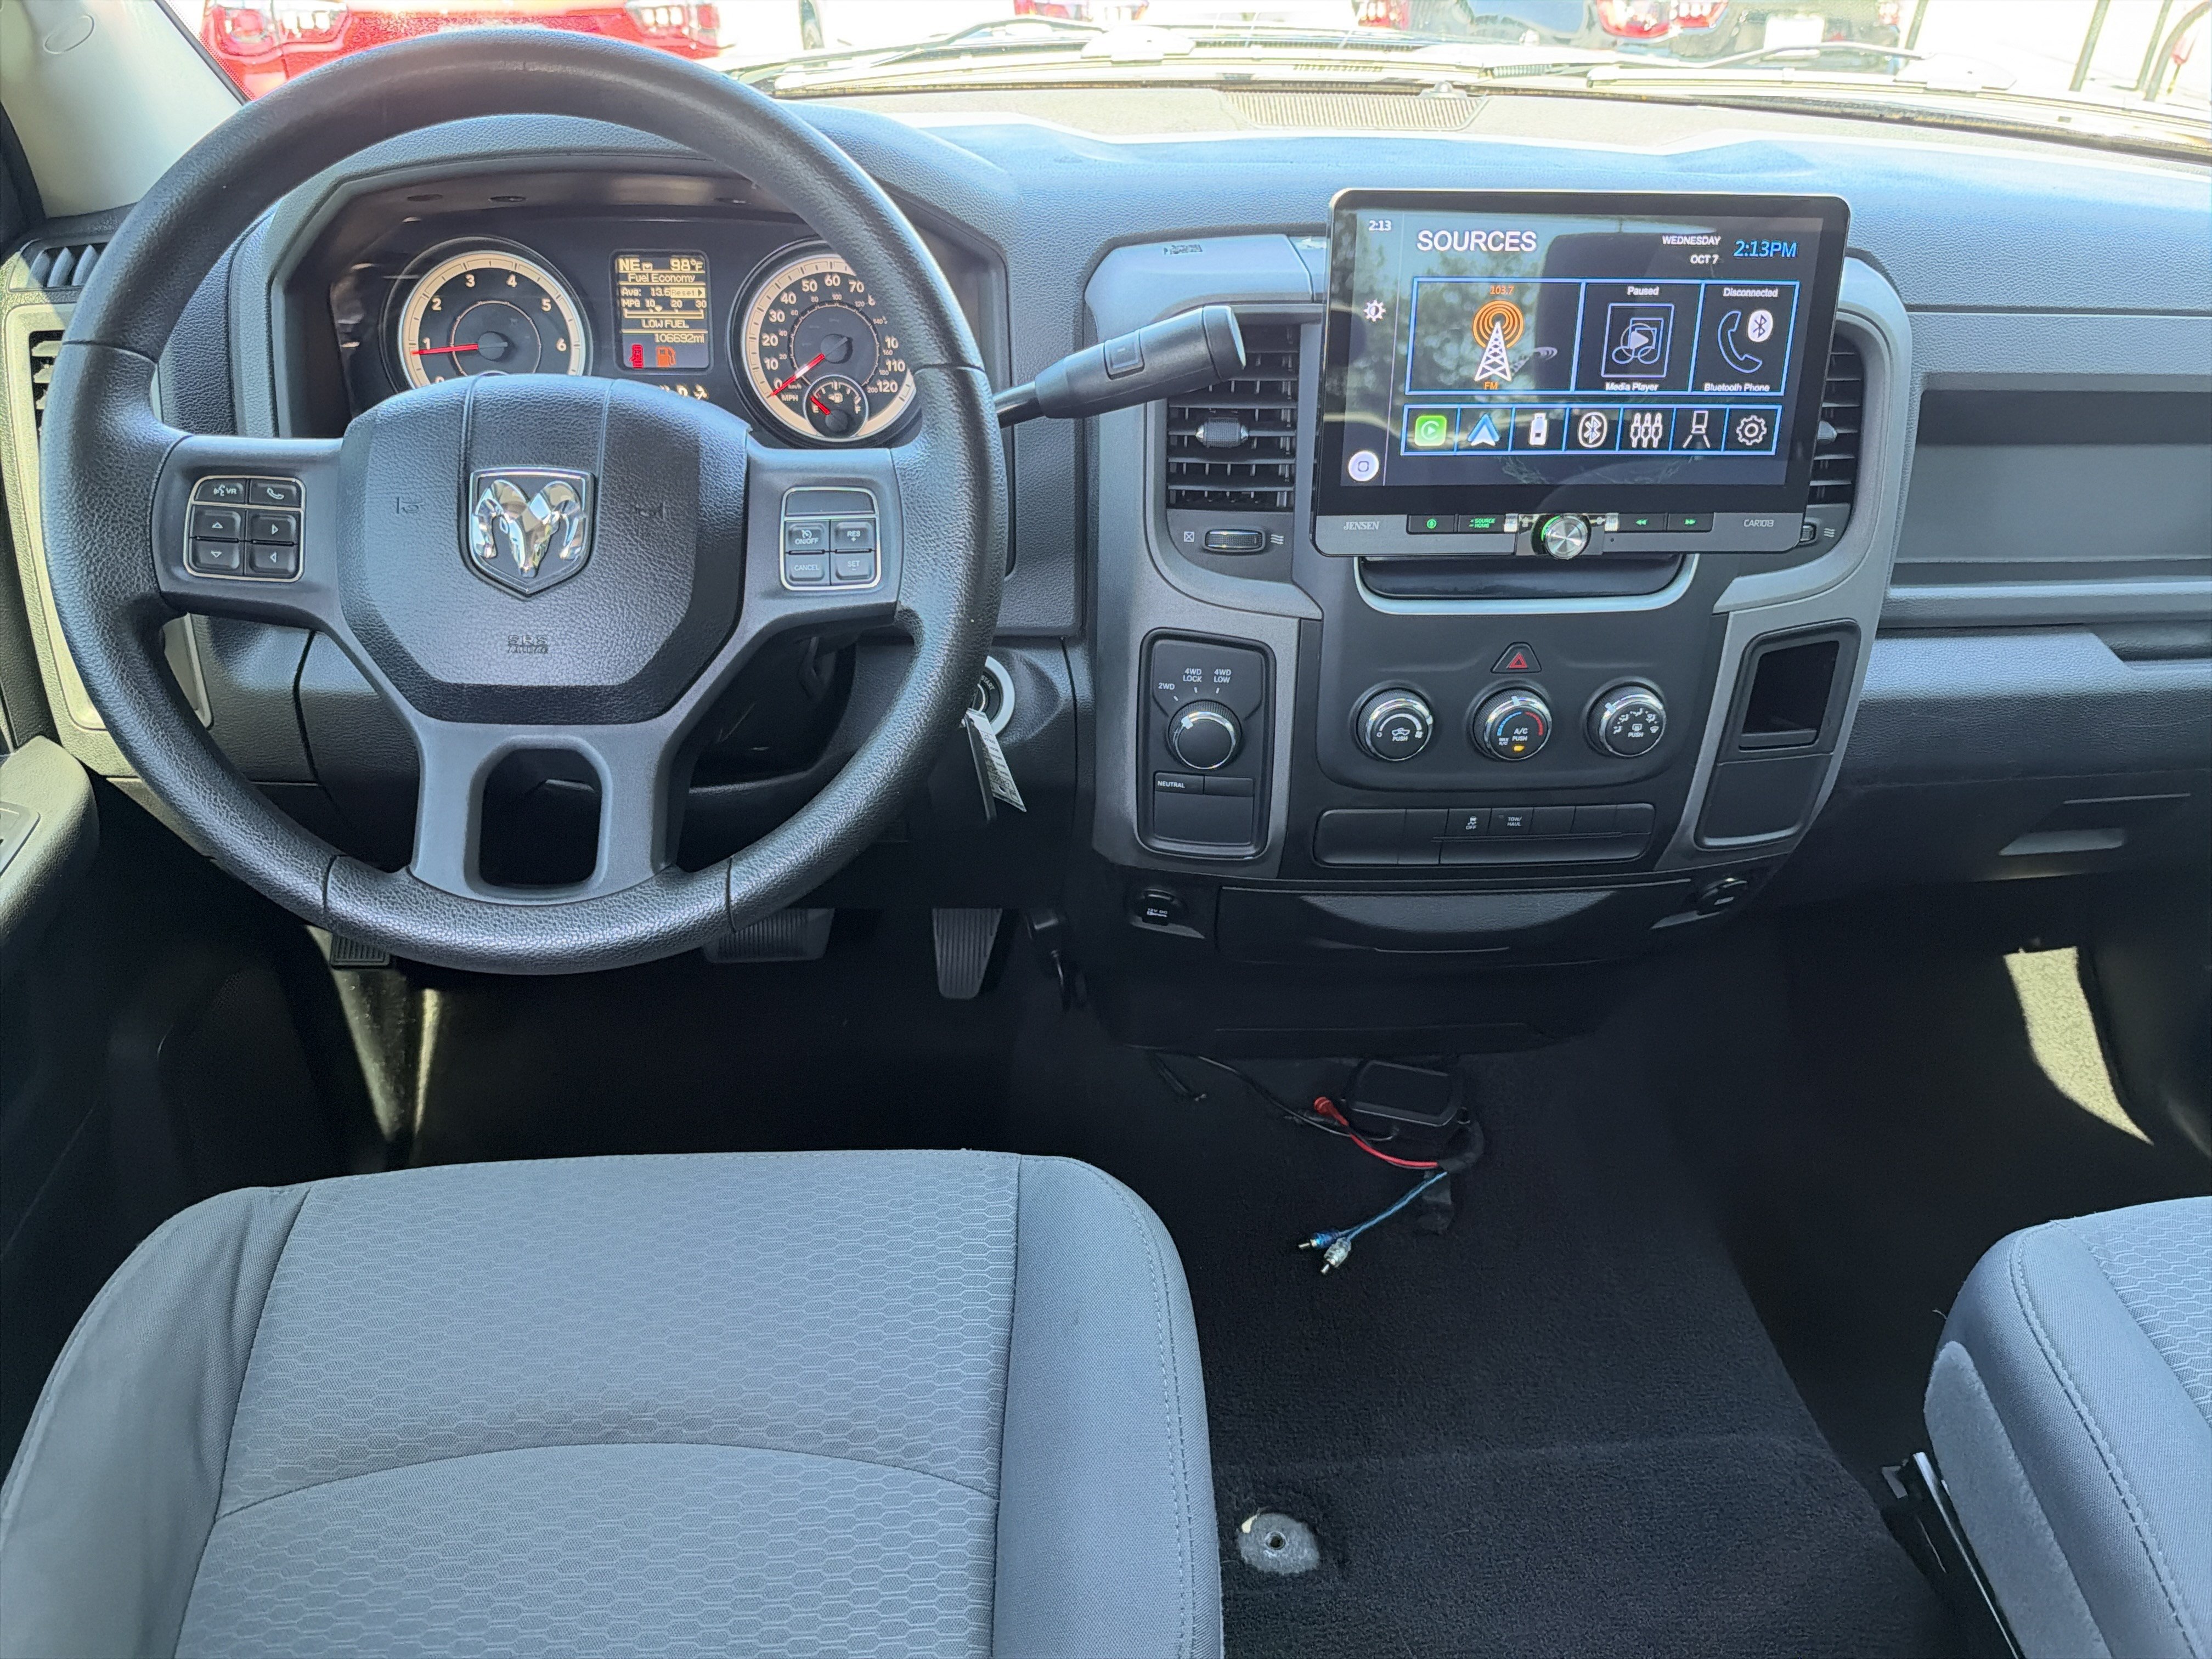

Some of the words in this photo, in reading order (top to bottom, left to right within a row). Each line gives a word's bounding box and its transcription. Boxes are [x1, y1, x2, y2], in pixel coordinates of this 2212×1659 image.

[1368, 220, 1392, 231] 2:13
[1417, 230, 1537, 251] SOURCES
[1662, 235, 1722, 245] WEDNESDAY
[1734, 240, 1797, 257] 2:13PM
[618, 258, 641, 271] NE
[1690, 254, 1711, 264] OCT
[1712, 255, 1719, 264] 7
[465, 274, 475, 287] 3
[506, 274, 517, 287] 4
[628, 274, 650, 282] Fuel
[651, 274, 695, 283] Economy
[825, 274, 841, 286] 60
[802, 279, 817, 292] 50
[849, 279, 865, 293] 70
[1489, 285, 1515, 295] 103.7
[1627, 286, 1660, 296] Paused
[780, 291, 797, 304] 40
[1723, 287, 1779, 297] Disconnected
[431, 298, 442, 311] 2
[541, 298, 551, 312] 5
[621, 298, 641, 307] MPG
[645, 298, 656, 307] 10
[670, 300, 682, 308] 20
[695, 300, 707, 308] 30
[769, 309, 785, 323] 30
[641, 319, 663, 328] LOW
[664, 319, 690, 328] FUEL
[422, 338, 430, 349] 1
[556, 338, 567, 351] 6
[762, 333, 778, 346] 20
[885, 335, 899, 349] 10
[763, 357, 778, 370] 10
[886, 359, 905, 372] 110
[877, 379, 898, 393] 120
[1483, 382, 1498, 390] FM
[1606, 382, 1631, 391] Media
[1632, 382, 1660, 393] Player
[1704, 383, 1742, 392] Bluetooth
[1743, 383, 1770, 392] Phone
[811, 404, 819, 413] E
[855, 405, 861, 414] F
[1344, 521, 1380, 531] JENSEN
[1743, 519, 1774, 527] CAR1013
[508, 635, 548, 645] SRS
[980, 675, 995, 690] START
